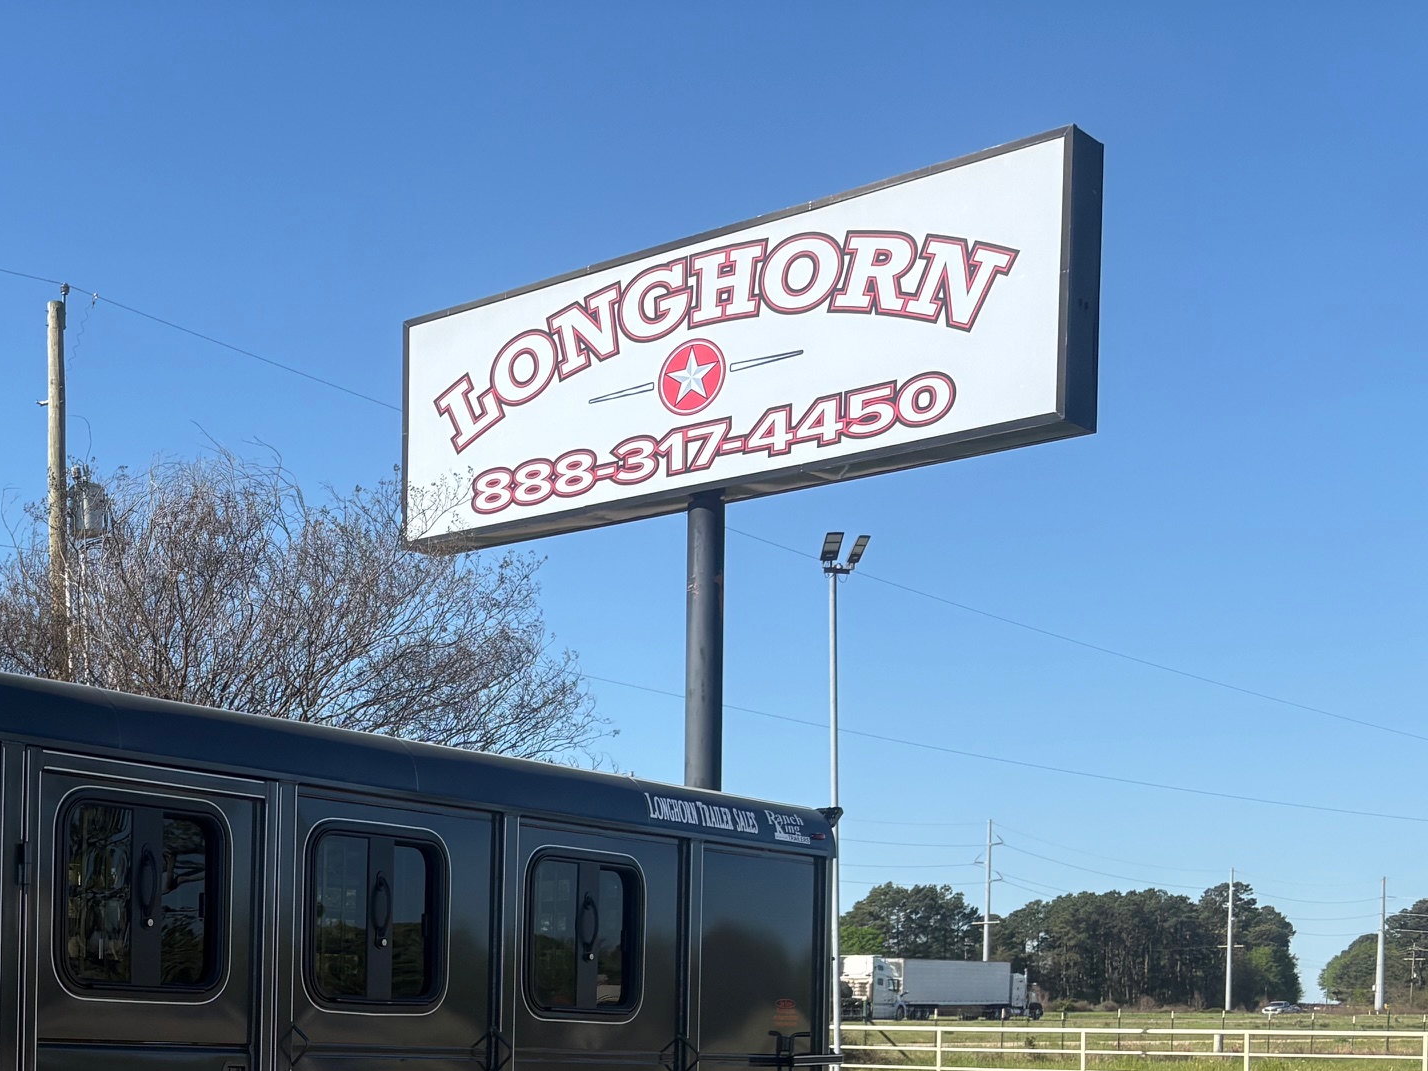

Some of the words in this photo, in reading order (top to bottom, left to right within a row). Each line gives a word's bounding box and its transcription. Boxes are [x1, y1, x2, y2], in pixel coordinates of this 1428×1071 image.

[434, 230, 1020, 454] LONGHORN
[471, 371, 956, 514] 888-317-4450
[644, 792, 699, 825] LONGHORN
[695, 801, 734, 830] TRAILER
[732, 808, 759, 834] SALES
[764, 809, 804, 826] Ranch
[774, 820, 802, 836] King
[788, 834, 810, 844] TRAILERS
